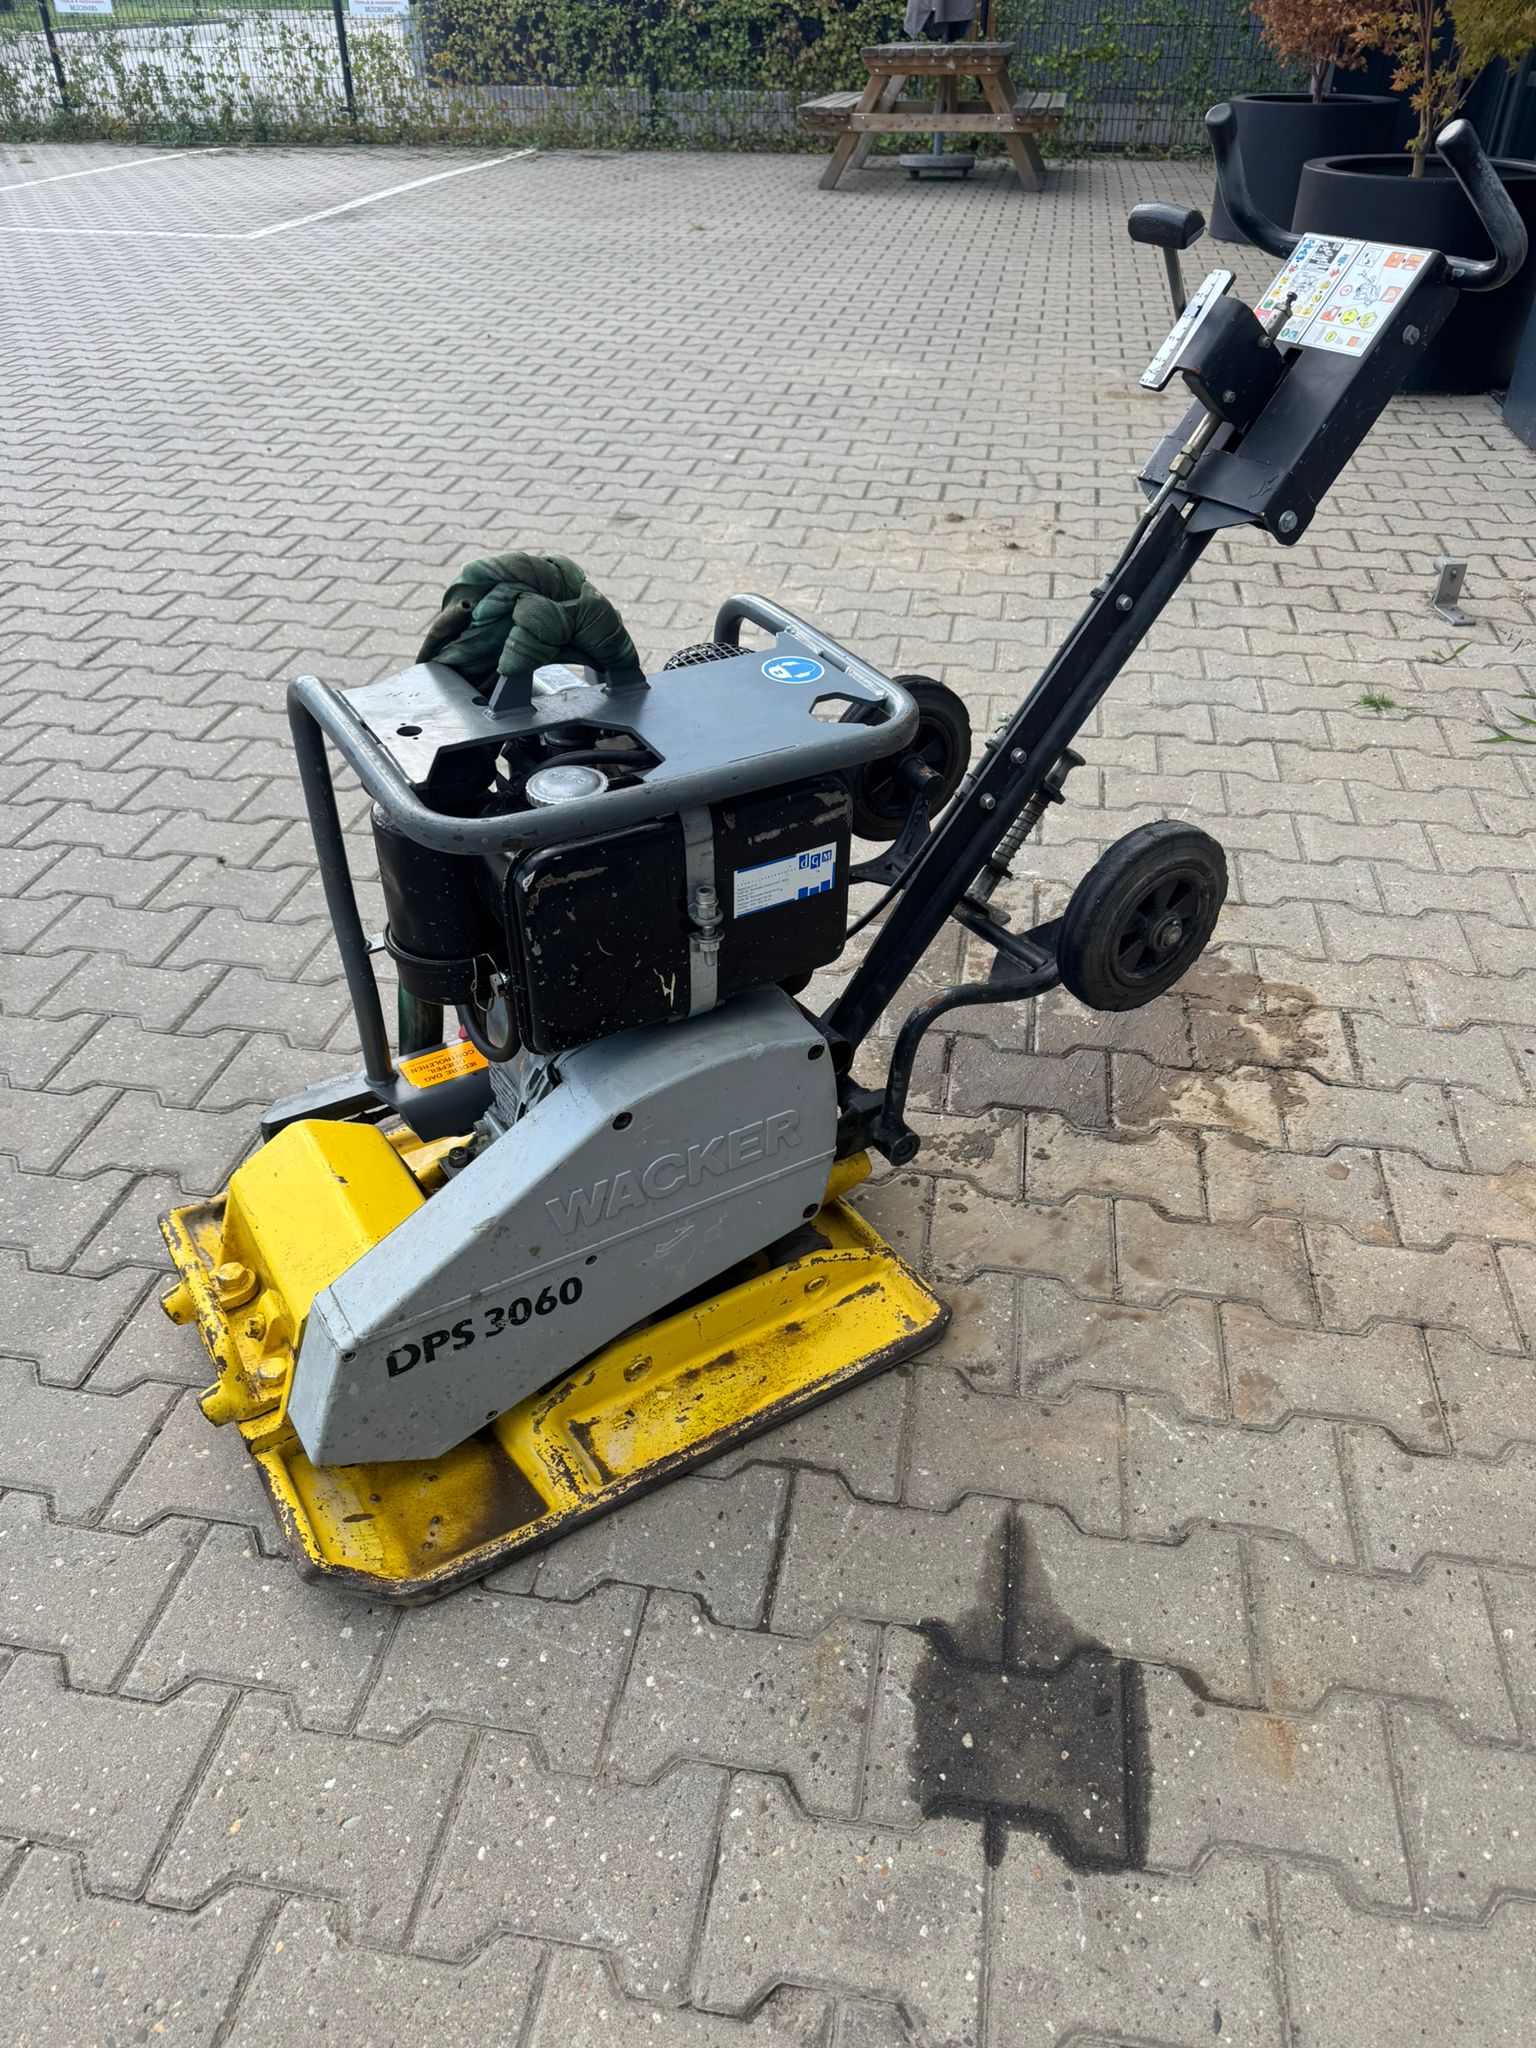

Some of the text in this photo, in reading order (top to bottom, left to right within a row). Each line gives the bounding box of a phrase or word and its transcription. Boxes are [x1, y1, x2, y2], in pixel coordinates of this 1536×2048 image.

[424, 1072, 443, 1082] DAG
[545, 1109, 801, 1235] WACKER
[386, 1276, 584, 1378] DPS 3060
